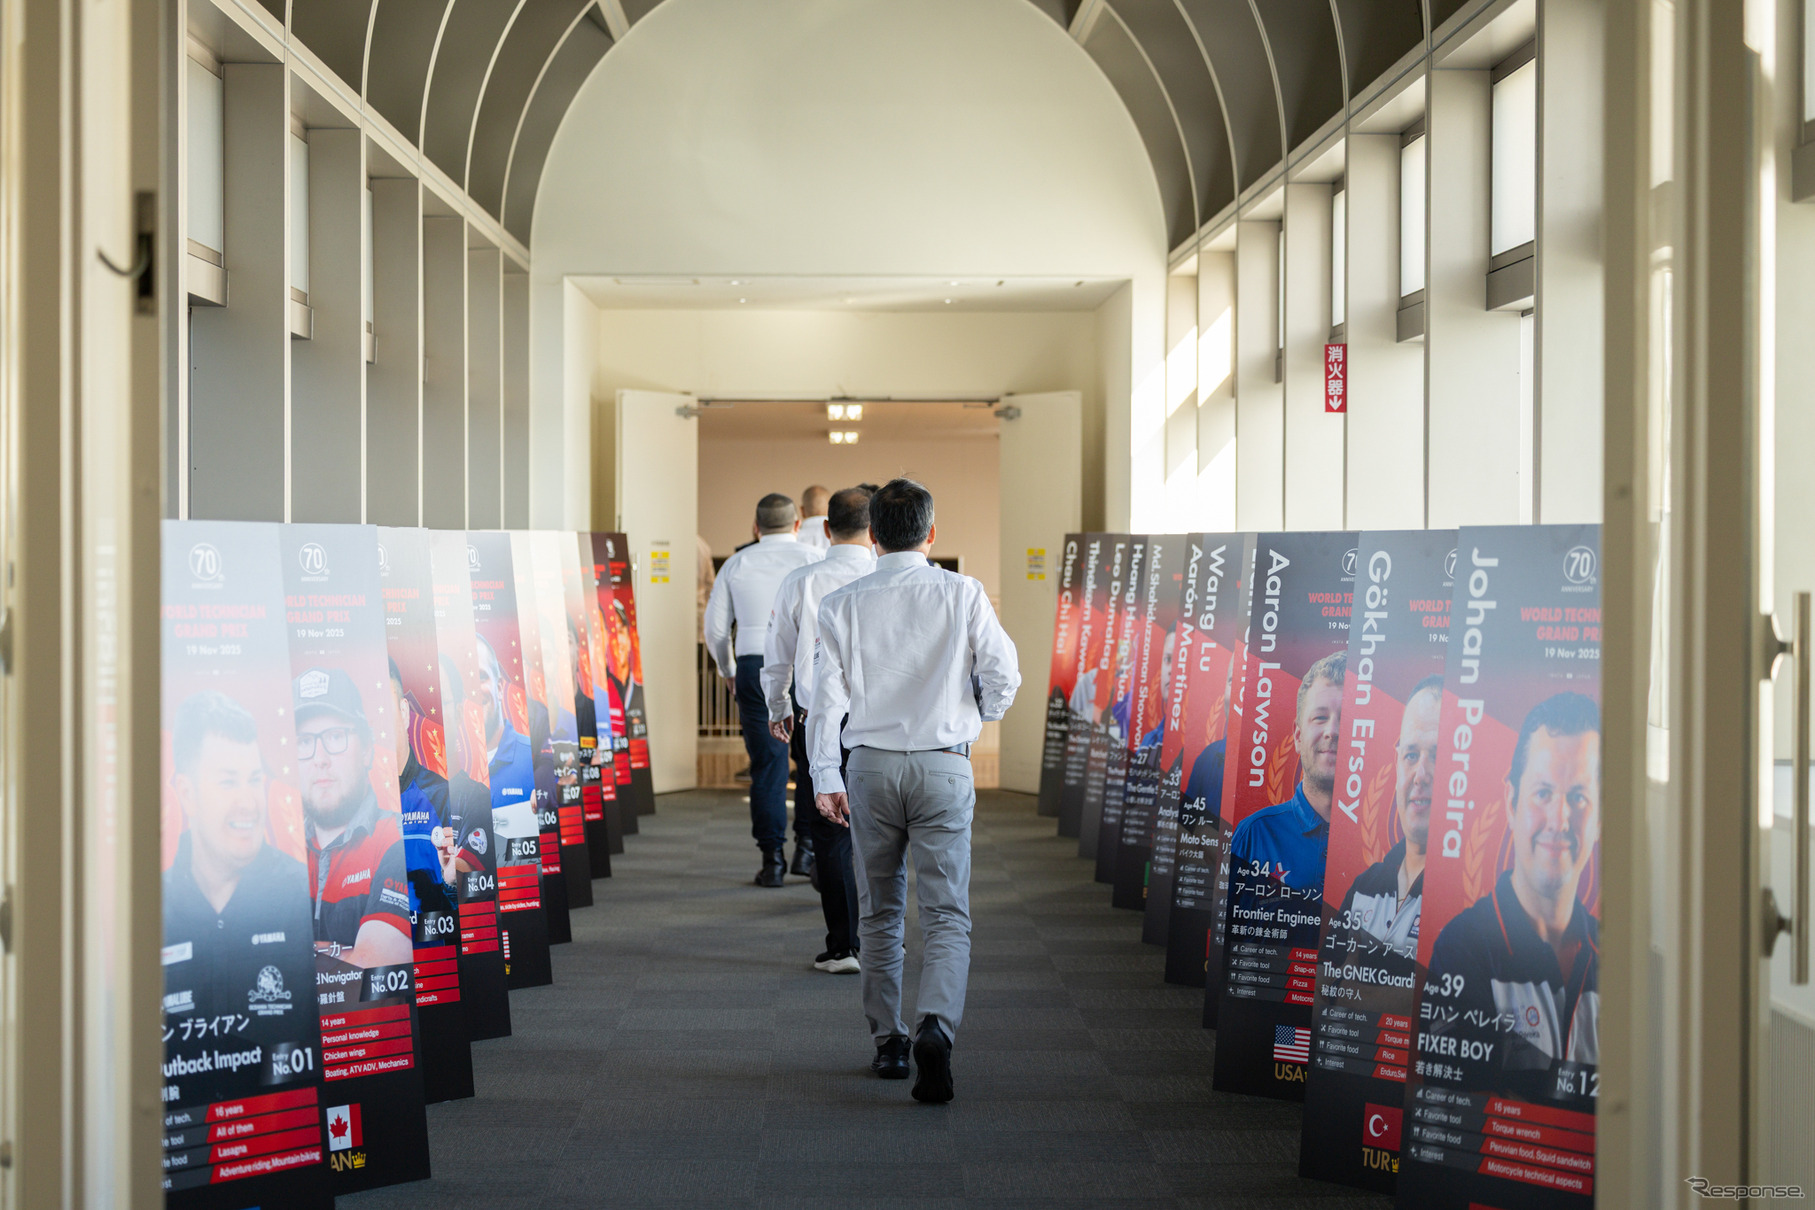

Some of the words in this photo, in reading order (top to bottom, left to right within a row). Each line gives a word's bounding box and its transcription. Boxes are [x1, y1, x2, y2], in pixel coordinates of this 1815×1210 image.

[1328, 346, 1343, 395] 消火器
[194, 549, 217, 575] 70
[303, 548, 323, 570] 70
[1112, 542, 1126, 578] Leo
[1569, 552, 1591, 578] 70
[1125, 543, 1144, 605] Huang
[1183, 544, 1203, 618] Aarón
[1198, 544, 1227, 630] Wang
[307, 594, 366, 607] TECHNICIAN
[1260, 549, 1290, 653] Aaron
[1308, 592, 1342, 603] WORLD
[199, 604, 267, 619] TECHNICIAN
[1059, 590, 1073, 621] Chi
[1409, 600, 1443, 612] WORLD
[286, 610, 324, 624] GRAND
[326, 610, 351, 623] PRIX
[386, 617, 402, 625] 2025
[1459, 547, 1499, 684] Johan
[1520, 607, 1563, 622] WORLD
[174, 623, 218, 638] GRAND
[220, 622, 249, 638] PRIX
[296, 629, 307, 638] 19
[307, 629, 324, 638] Nov
[325, 628, 345, 638] 2025
[1100, 580, 1121, 671] Dumalag
[1328, 622, 1337, 630] 19
[1355, 551, 1392, 705] Gökhan
[1056, 624, 1069, 654] Hai
[1429, 634, 1438, 642] 19
[1536, 626, 1579, 641] GRAND
[186, 644, 197, 655] 19
[199, 645, 217, 655] Nov
[219, 644, 242, 655] 2025
[1199, 642, 1217, 672] Lu
[1544, 647, 1555, 658] 19
[1557, 648, 1575, 659] Nov
[1577, 648, 1600, 659] 2025
[1170, 622, 1195, 732] Martínez
[1249, 662, 1281, 787] Lawson
[1136, 753, 1148, 765] 27
[1338, 719, 1375, 824] Ersoy
[1442, 699, 1485, 859] Pereira
[1169, 773, 1180, 787] 33
[570, 786, 580, 800] 07
[1183, 802, 1194, 811] Age
[1192, 797, 1206, 811] 45
[403, 811, 430, 822] YAMAHA
[544, 811, 557, 825] 06
[1180, 832, 1200, 845] Moto
[522, 840, 537, 856] 05
[1237, 866, 1250, 877] Age
[1250, 860, 1271, 878] 34
[468, 883, 480, 892] No.
[479, 874, 495, 890] 04
[1235, 882, 1277, 897] アーロン
[1280, 886, 1323, 901] ローソン
[1233, 905, 1275, 921] Frontier
[1277, 908, 1321, 927] Enginee
[1328, 917, 1342, 929] Age
[1342, 910, 1362, 931] 35
[424, 925, 439, 936] No.
[437, 915, 455, 934] 03
[1325, 934, 1378, 954] ゴーカーン
[1302, 952, 1318, 960] years
[321, 970, 363, 985] Navigator
[370, 974, 385, 982] Entry
[1323, 961, 1342, 978] The
[1343, 964, 1378, 984] GNEK
[371, 982, 388, 994] No.
[387, 970, 409, 991] 02
[1292, 979, 1308, 988] Pizza
[1423, 981, 1440, 995] Age
[1440, 973, 1465, 998] 39
[1329, 1008, 1347, 1019] Career
[1420, 1002, 1460, 1023] ヨハン
[1463, 1009, 1516, 1033] ペレイラ
[179, 1014, 250, 1041] ブライアン
[321, 1019, 329, 1027] 14
[329, 1017, 346, 1027] years
[1385, 1017, 1393, 1026] 20
[1393, 1019, 1409, 1028] years
[322, 1033, 348, 1044] Personal
[348, 1029, 379, 1040] knowledge
[1327, 1025, 1348, 1036] Favorite
[1349, 1029, 1360, 1038] tool
[1384, 1033, 1402, 1046] Torque
[323, 1050, 348, 1061] Chicken
[348, 1047, 366, 1058] wings
[1326, 1041, 1347, 1052] Favorite
[1347, 1044, 1359, 1054] food
[1382, 1050, 1395, 1060] Rice
[1417, 1033, 1457, 1056] FIXER
[1460, 1039, 1494, 1062] BOY
[161, 1050, 213, 1078] utback
[214, 1046, 262, 1072] Impact
[272, 1053, 289, 1061] Entry
[291, 1047, 314, 1073] 01
[1324, 1058, 1345, 1069] Interest
[272, 1061, 292, 1076] No.
[325, 1067, 349, 1078] Boating,
[349, 1064, 362, 1074] ATV
[362, 1062, 378, 1073] ADV,
[378, 1058, 409, 1070] Mechanics
[1274, 1062, 1305, 1083] USA
[1558, 1067, 1576, 1079] Entry
[1556, 1077, 1576, 1094] No.
[1580, 1071, 1601, 1097] 12
[1425, 1090, 1447, 1102] Career
[215, 1106, 225, 1117] 16
[225, 1104, 244, 1117] years
[1423, 1109, 1448, 1122] Favorite
[1449, 1114, 1462, 1124] tool
[1494, 1102, 1503, 1112] 16
[1503, 1105, 1521, 1116] years
[216, 1127, 226, 1138] All
[236, 1123, 254, 1134] them
[1422, 1128, 1446, 1142] Favorite
[1447, 1133, 1462, 1145] food
[1492, 1121, 1515, 1136] Torque
[1516, 1128, 1541, 1140] wrench
[217, 1144, 248, 1158] Lasagna
[1420, 1148, 1444, 1161] Interest
[1489, 1141, 1518, 1155] Peruvian
[1519, 1147, 1535, 1160] food,
[1536, 1151, 1556, 1164] Squid
[1557, 1155, 1591, 1170] sandwitch
[171, 1155, 188, 1166] food
[219, 1163, 252, 1178] Adventure
[299, 1151, 321, 1162] biking
[1362, 1147, 1391, 1171] TUR
[1487, 1161, 1524, 1177] Motorcycle
[1524, 1168, 1555, 1184] technical
[1555, 1175, 1583, 1189] aspects
